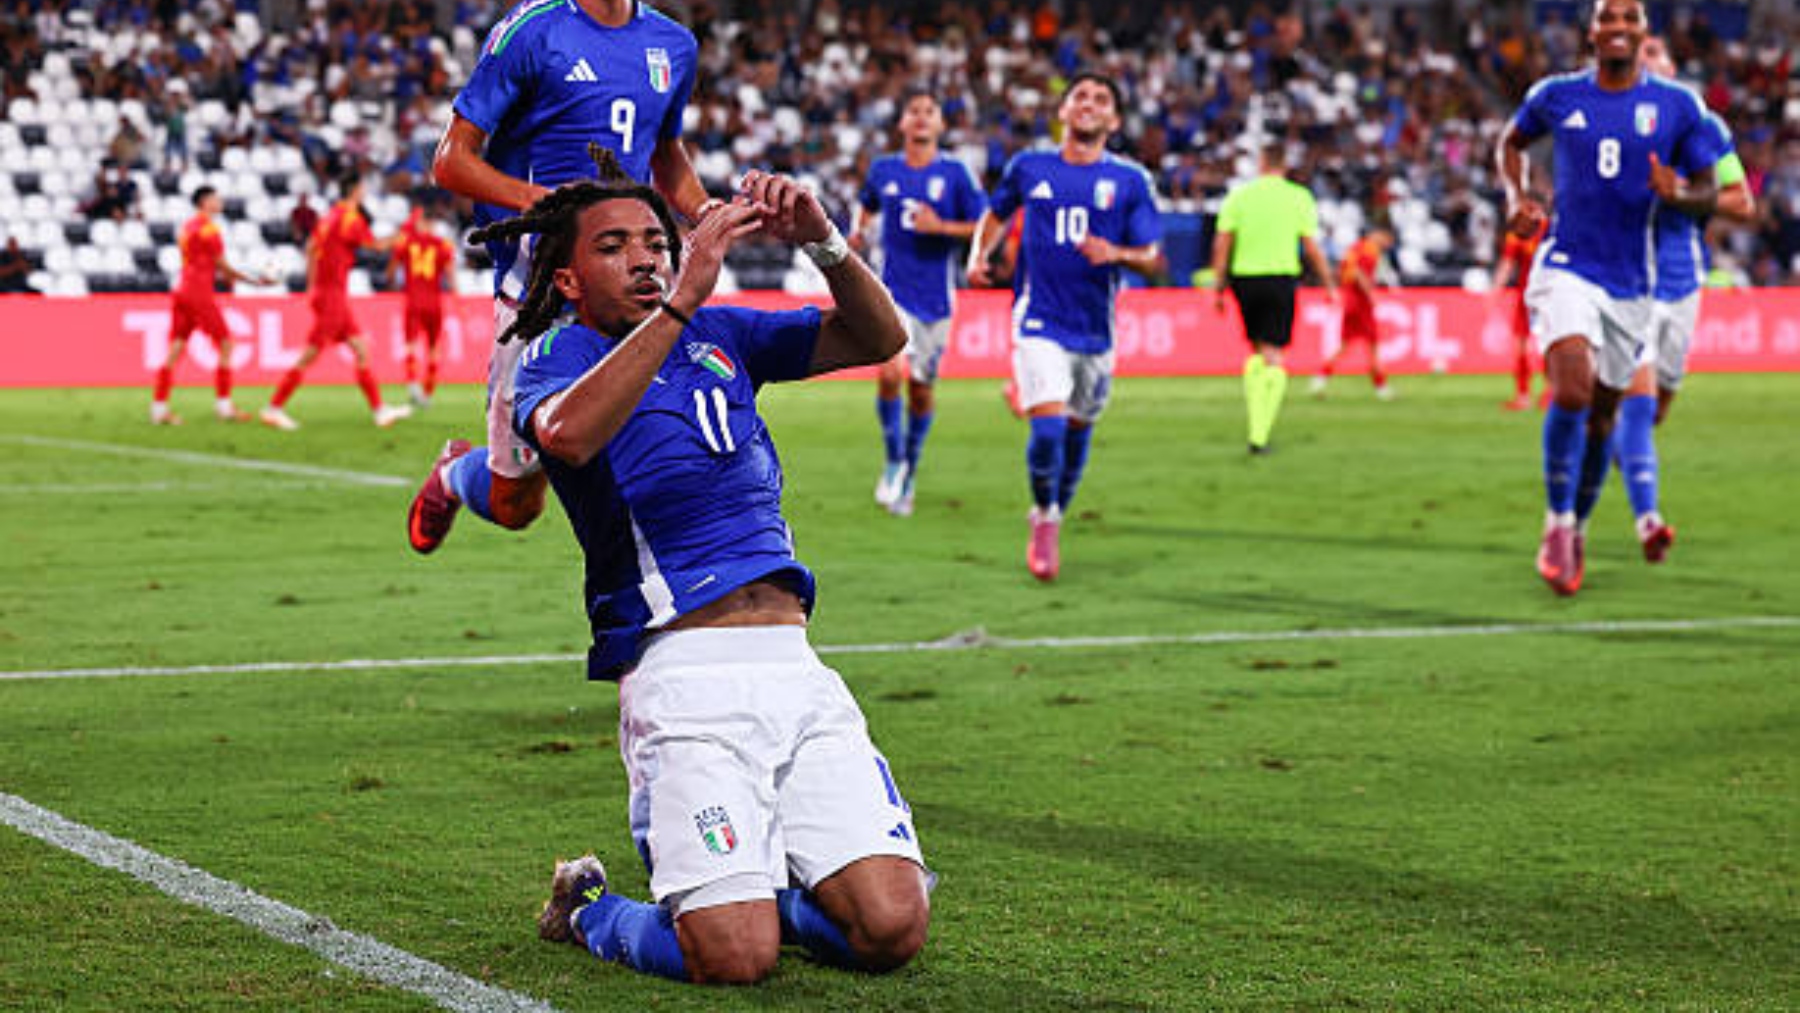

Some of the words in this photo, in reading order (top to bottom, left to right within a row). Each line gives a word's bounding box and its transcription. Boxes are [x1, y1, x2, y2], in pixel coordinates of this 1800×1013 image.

[610, 98, 636, 153] 9
[1598, 138, 1621, 178] 8
[1055, 207, 1088, 245] 10
[409, 243, 436, 278] 14
[1302, 301, 1462, 360] TCL
[693, 387, 736, 452] 11
